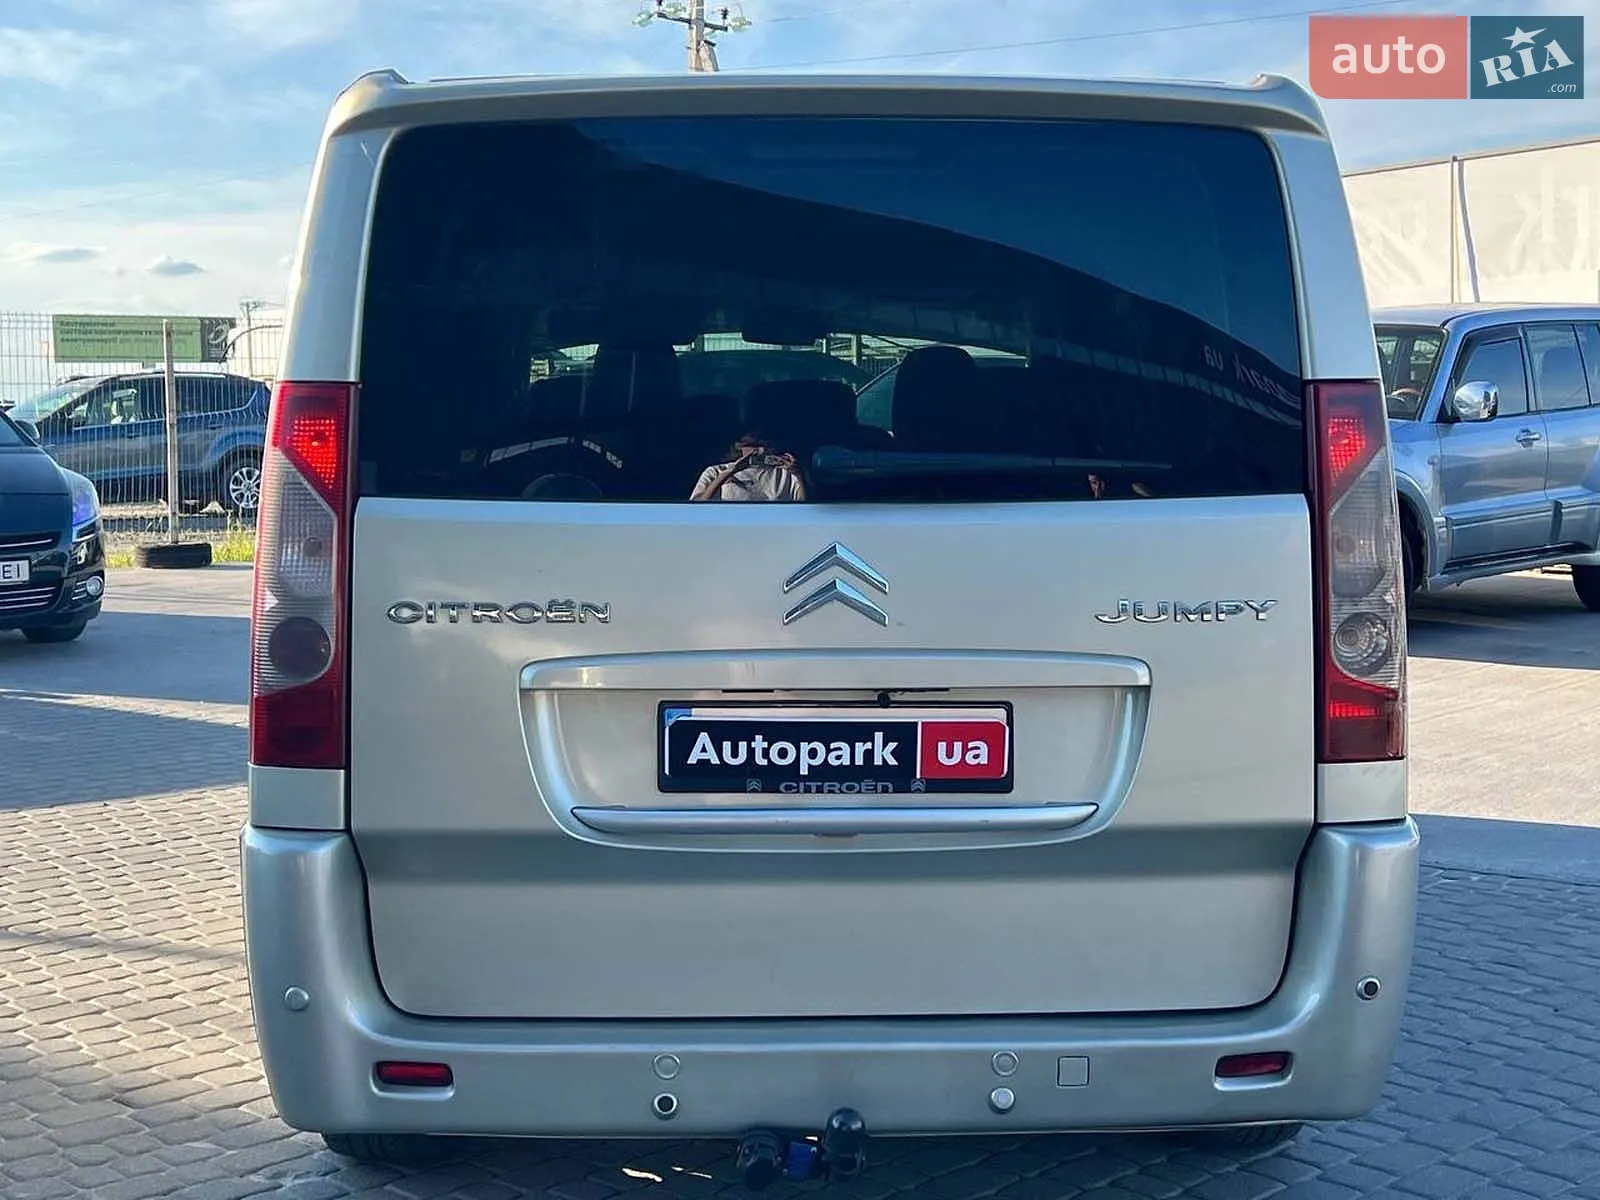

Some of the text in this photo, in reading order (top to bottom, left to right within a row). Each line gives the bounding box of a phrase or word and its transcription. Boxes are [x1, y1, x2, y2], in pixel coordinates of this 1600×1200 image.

[384, 598, 611, 624] CITROËN
[1094, 598, 1279, 624] JUMPY
[686, 731, 989, 776] Autopark ua
[778, 778, 894, 794] CITROËN
